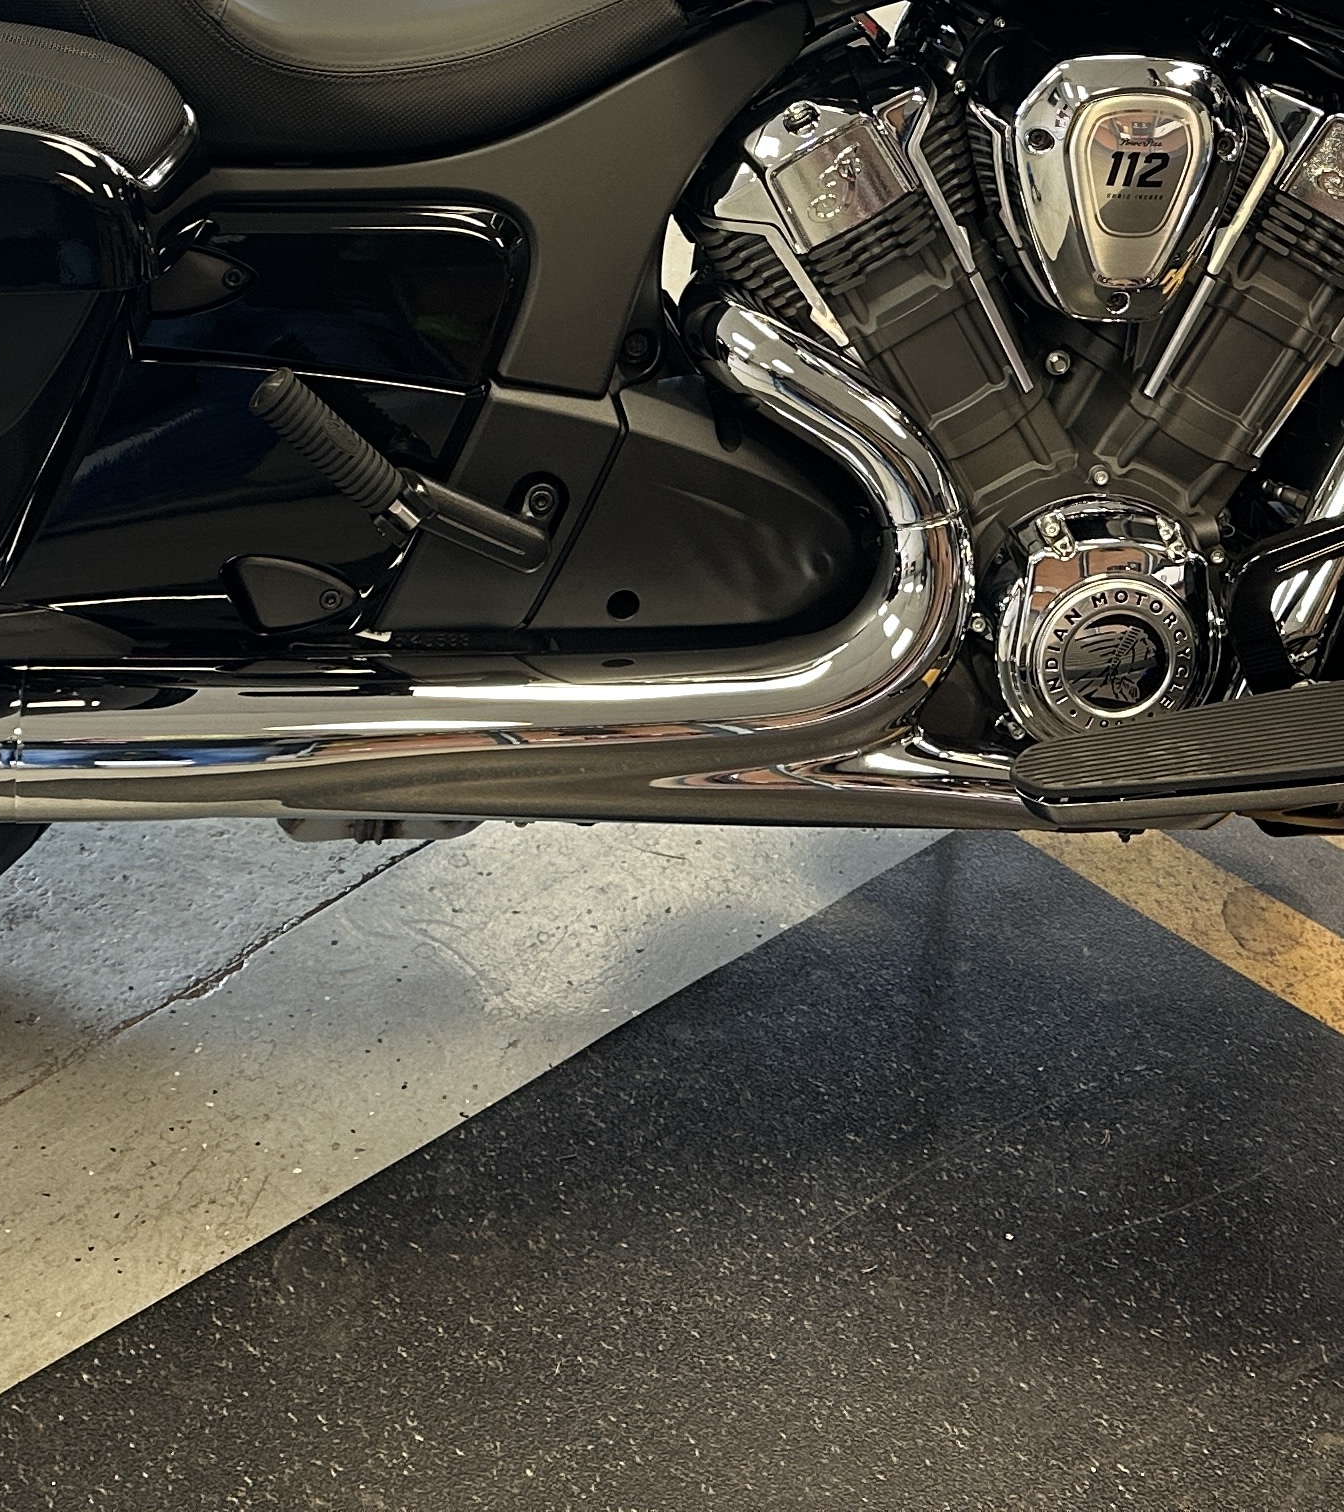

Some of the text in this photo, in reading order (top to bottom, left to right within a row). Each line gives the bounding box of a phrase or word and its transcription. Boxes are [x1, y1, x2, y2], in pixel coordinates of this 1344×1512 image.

[1106, 150, 1170, 188] 112
[1044, 589, 1194, 709] INDIAN MOTORCYCLE
